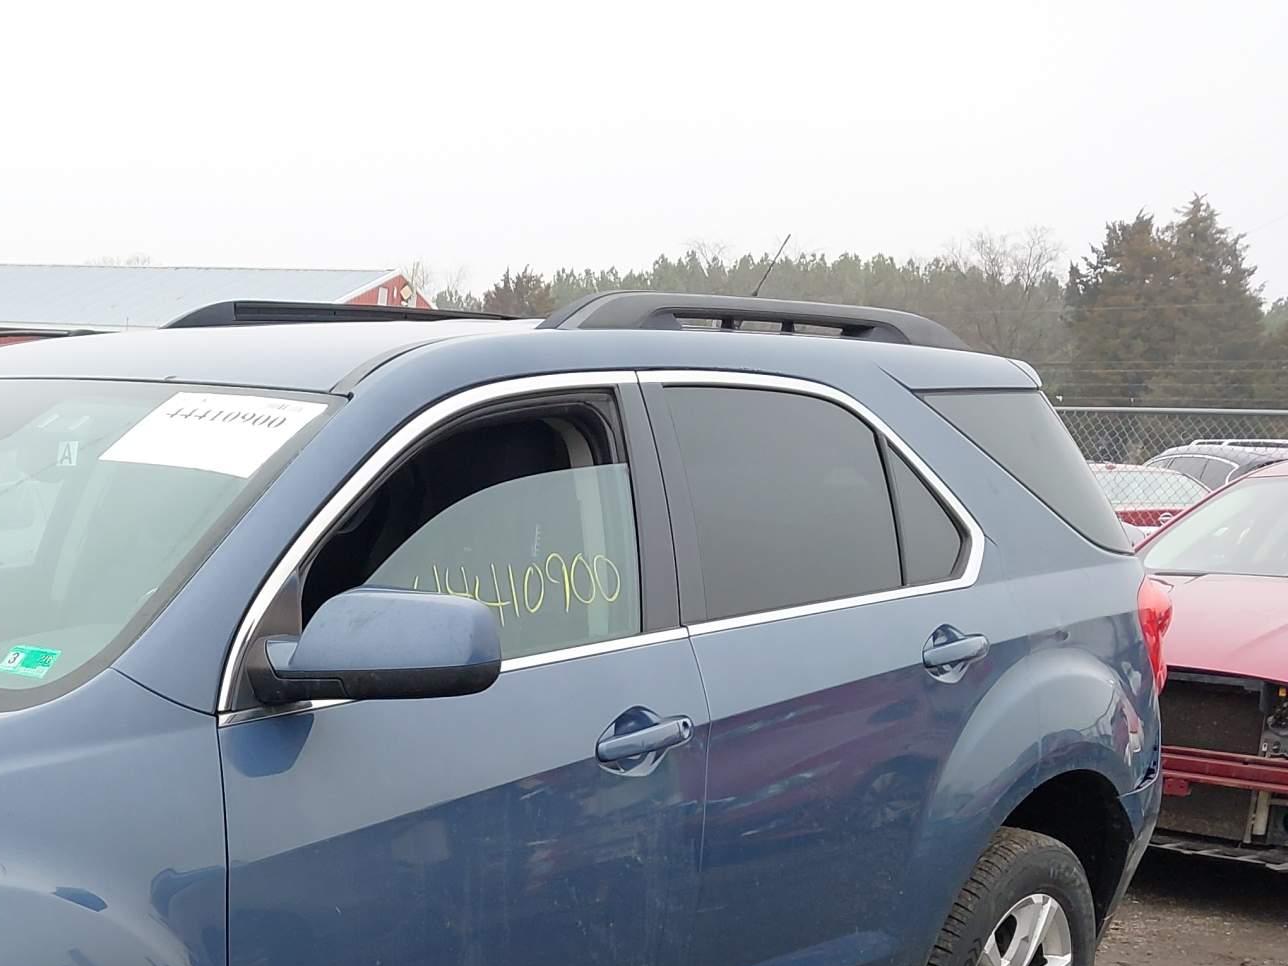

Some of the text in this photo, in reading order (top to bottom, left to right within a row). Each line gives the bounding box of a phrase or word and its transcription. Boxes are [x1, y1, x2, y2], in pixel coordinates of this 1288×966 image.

[165, 407, 287, 428] 44410900
[60, 443, 73, 464] A
[413, 552, 621, 627] 4410900
[8, 652, 20, 665] 3
